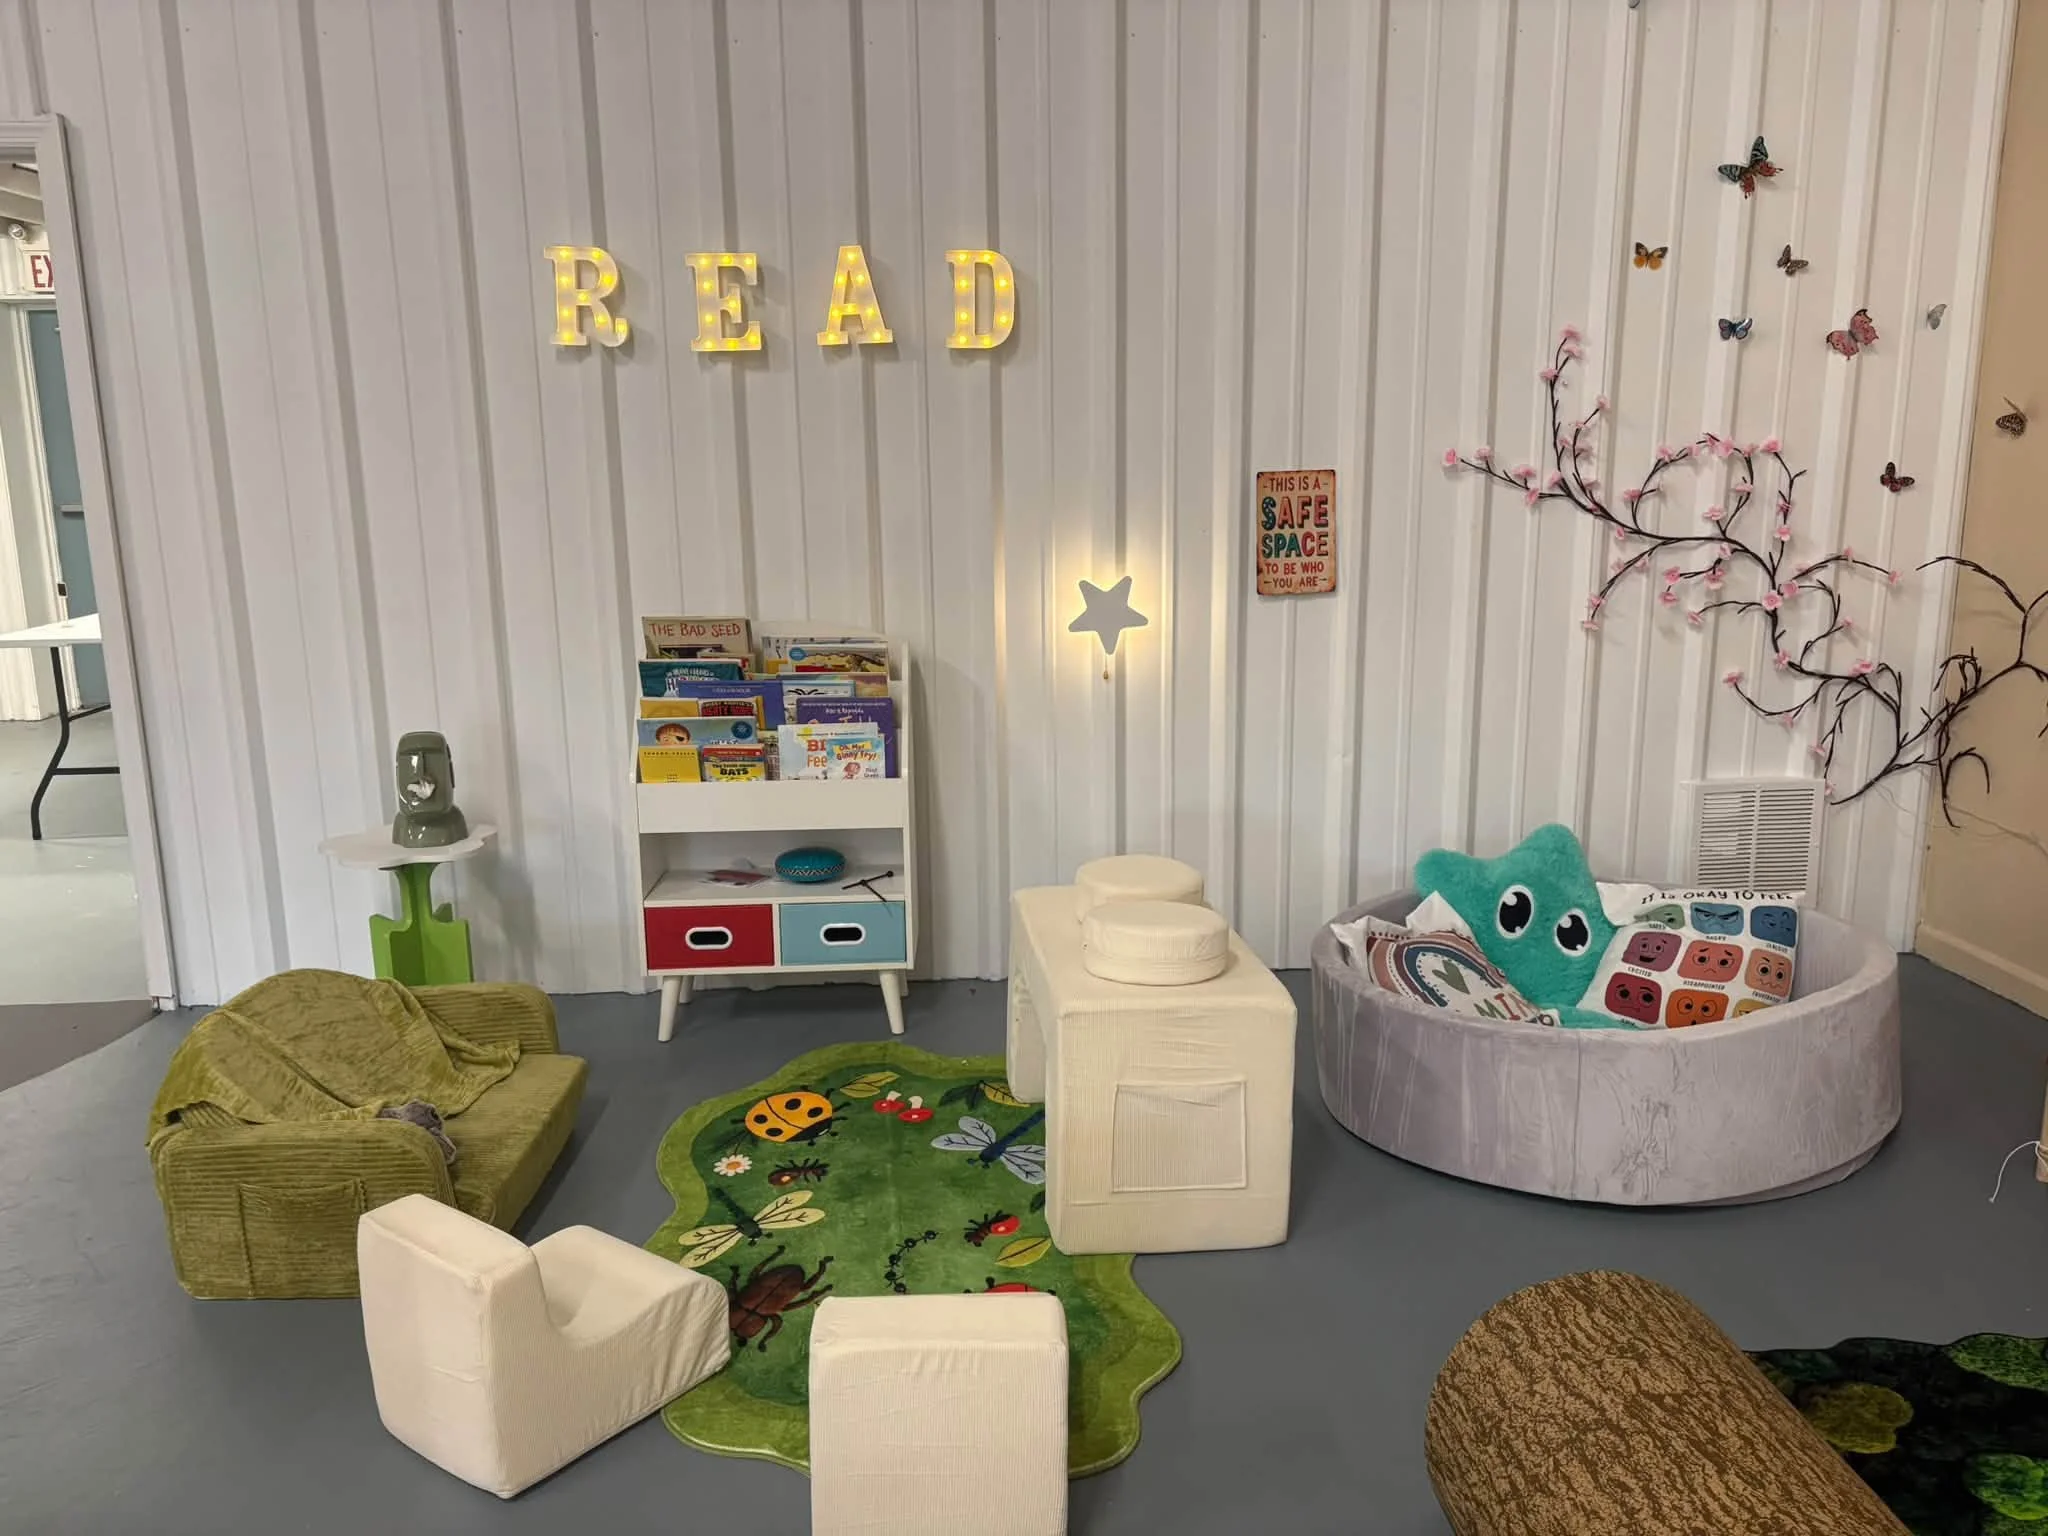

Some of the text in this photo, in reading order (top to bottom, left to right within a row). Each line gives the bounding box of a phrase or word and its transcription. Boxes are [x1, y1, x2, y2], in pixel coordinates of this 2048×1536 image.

[544, 245, 1015, 351] READ
[1270, 476, 1321, 492] THIS IS A
[1261, 495, 1329, 531] SAFE
[1261, 531, 1329, 559] SPACE
[1265, 561, 1325, 575] TO BE WHO
[1272, 576, 1319, 588] YOU ARE
[649, 623, 741, 637] THE BAD SEED
[719, 767, 749, 776] BATS
[1683, 890, 1728, 900] OKAY
[1733, 889, 1754, 900] TO
